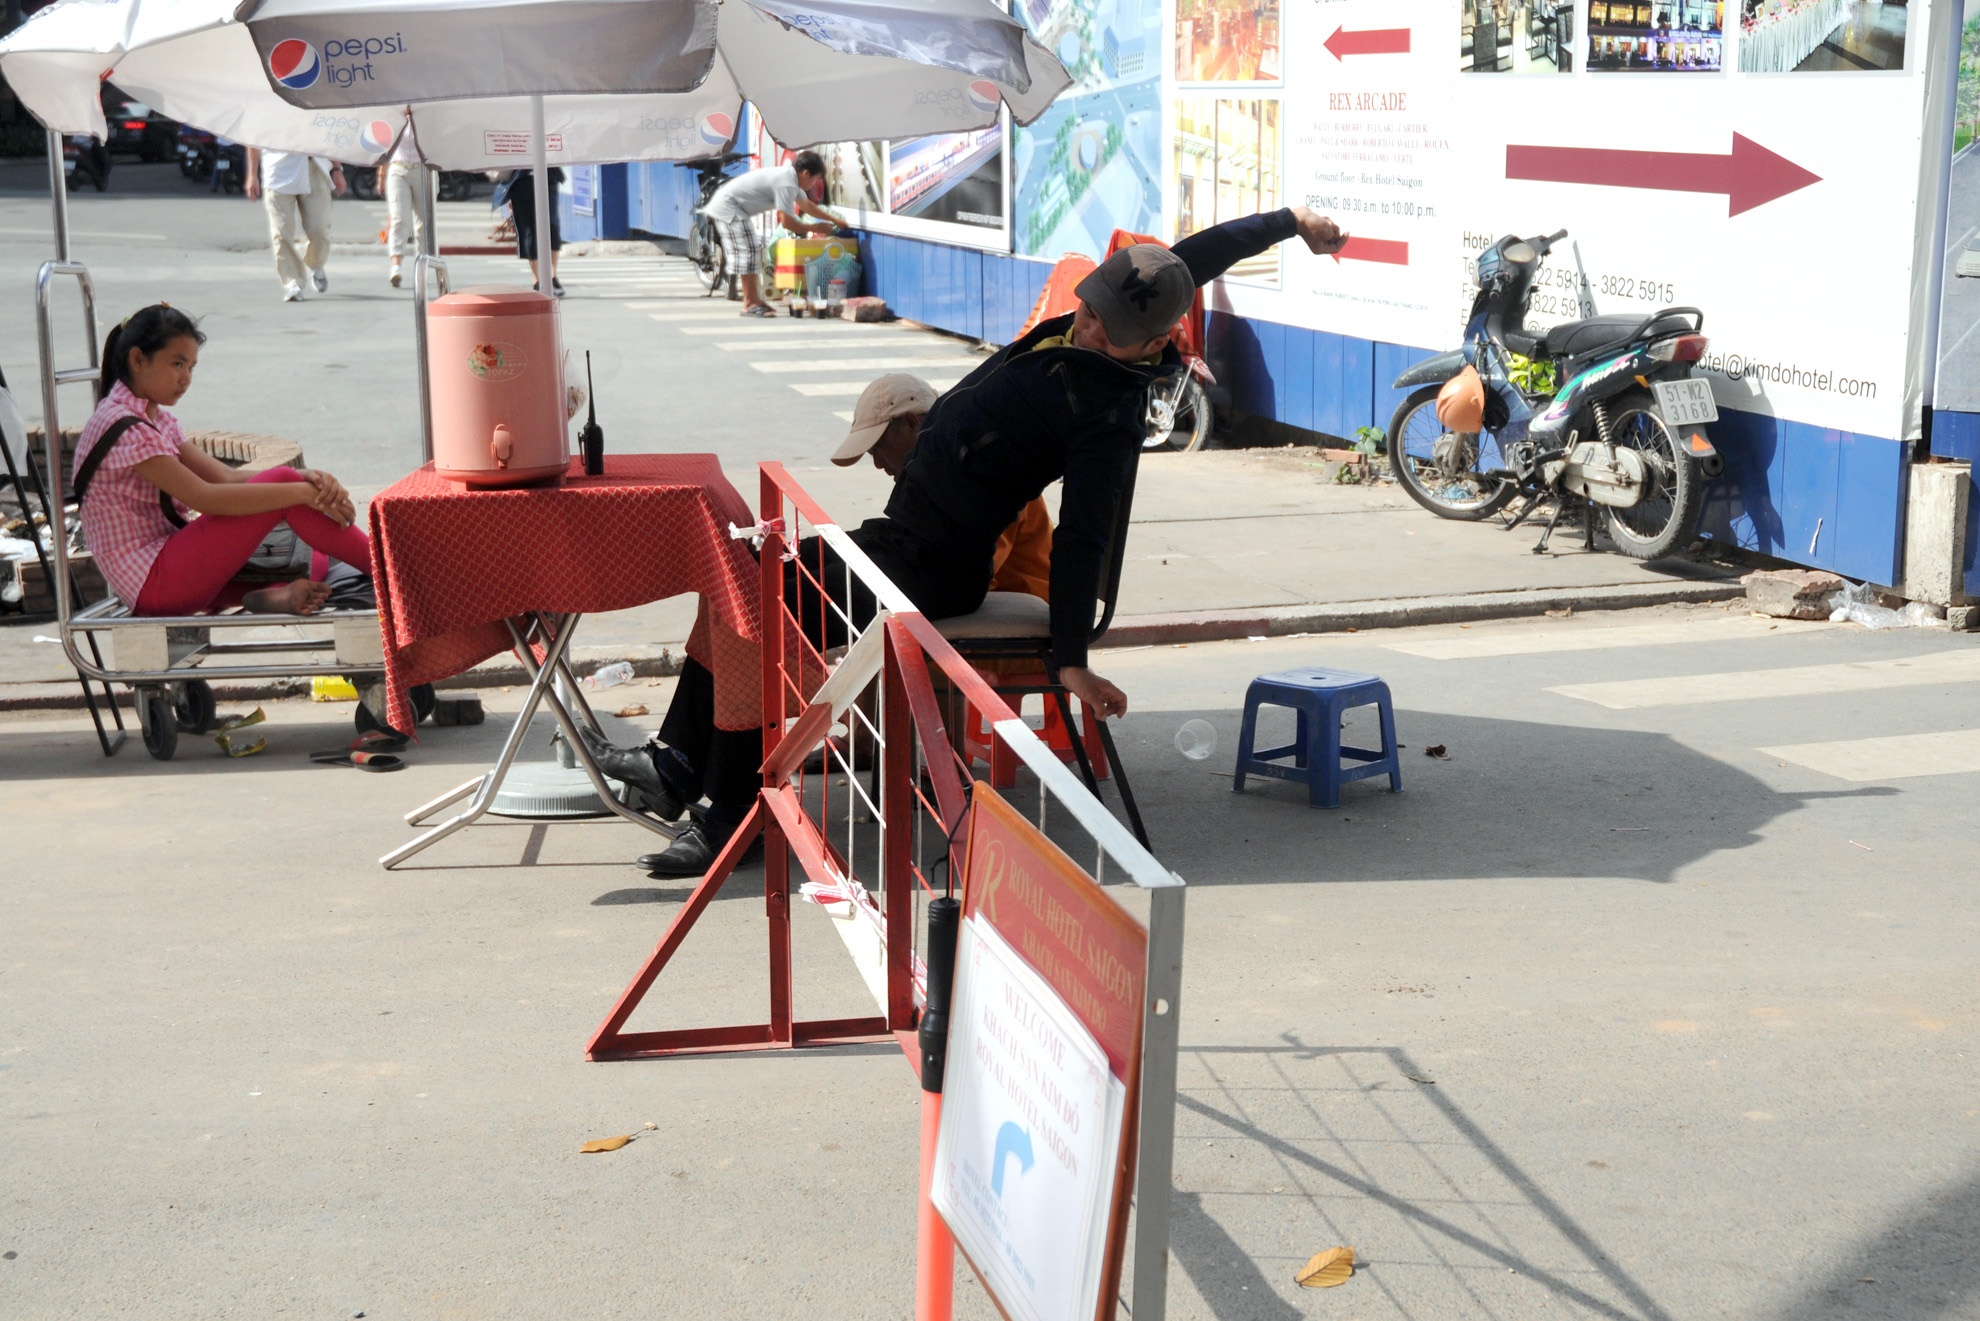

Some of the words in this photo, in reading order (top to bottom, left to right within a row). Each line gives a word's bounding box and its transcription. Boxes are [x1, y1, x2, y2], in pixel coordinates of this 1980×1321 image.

[324, 32, 403, 62] pepsi
[326, 62, 376, 88] light
[1329, 92, 1351, 111] REX
[1355, 92, 1407, 111] ARCADE
[1398, 123, 1428, 134] CARTIER
[1315, 171, 1339, 182] Ground
[1340, 171, 1355, 183] floor
[1361, 173, 1373, 184] Rex
[1375, 173, 1395, 186] Hotel
[1397, 175, 1423, 189] Saigon
[1381, 202, 1390, 214] to
[1392, 201, 1415, 216] 10:00
[1417, 205, 1437, 219] p.m.
[1556, 269, 1588, 289] 5914
[1601, 275, 1635, 298] 3822
[1638, 280, 1674, 303] 5915
[1561, 298, 1592, 319] 5913
[1695, 351, 1877, 400] otel@kimdohotel.com
[1670, 402, 1709, 422] 3168
[1008, 858, 1044, 922] ROYAL
[1046, 895, 1085, 962] HOTEL
[1087, 935, 1133, 1009] SAIGON
[1005, 981, 1066, 1072] WELCOME
[1041, 1071, 1062, 1115] KIM
[976, 1035, 1006, 1089] ROYAL
[1007, 1074, 1040, 1131] HOTEL
[1041, 1116, 1079, 1180] SAIGON
